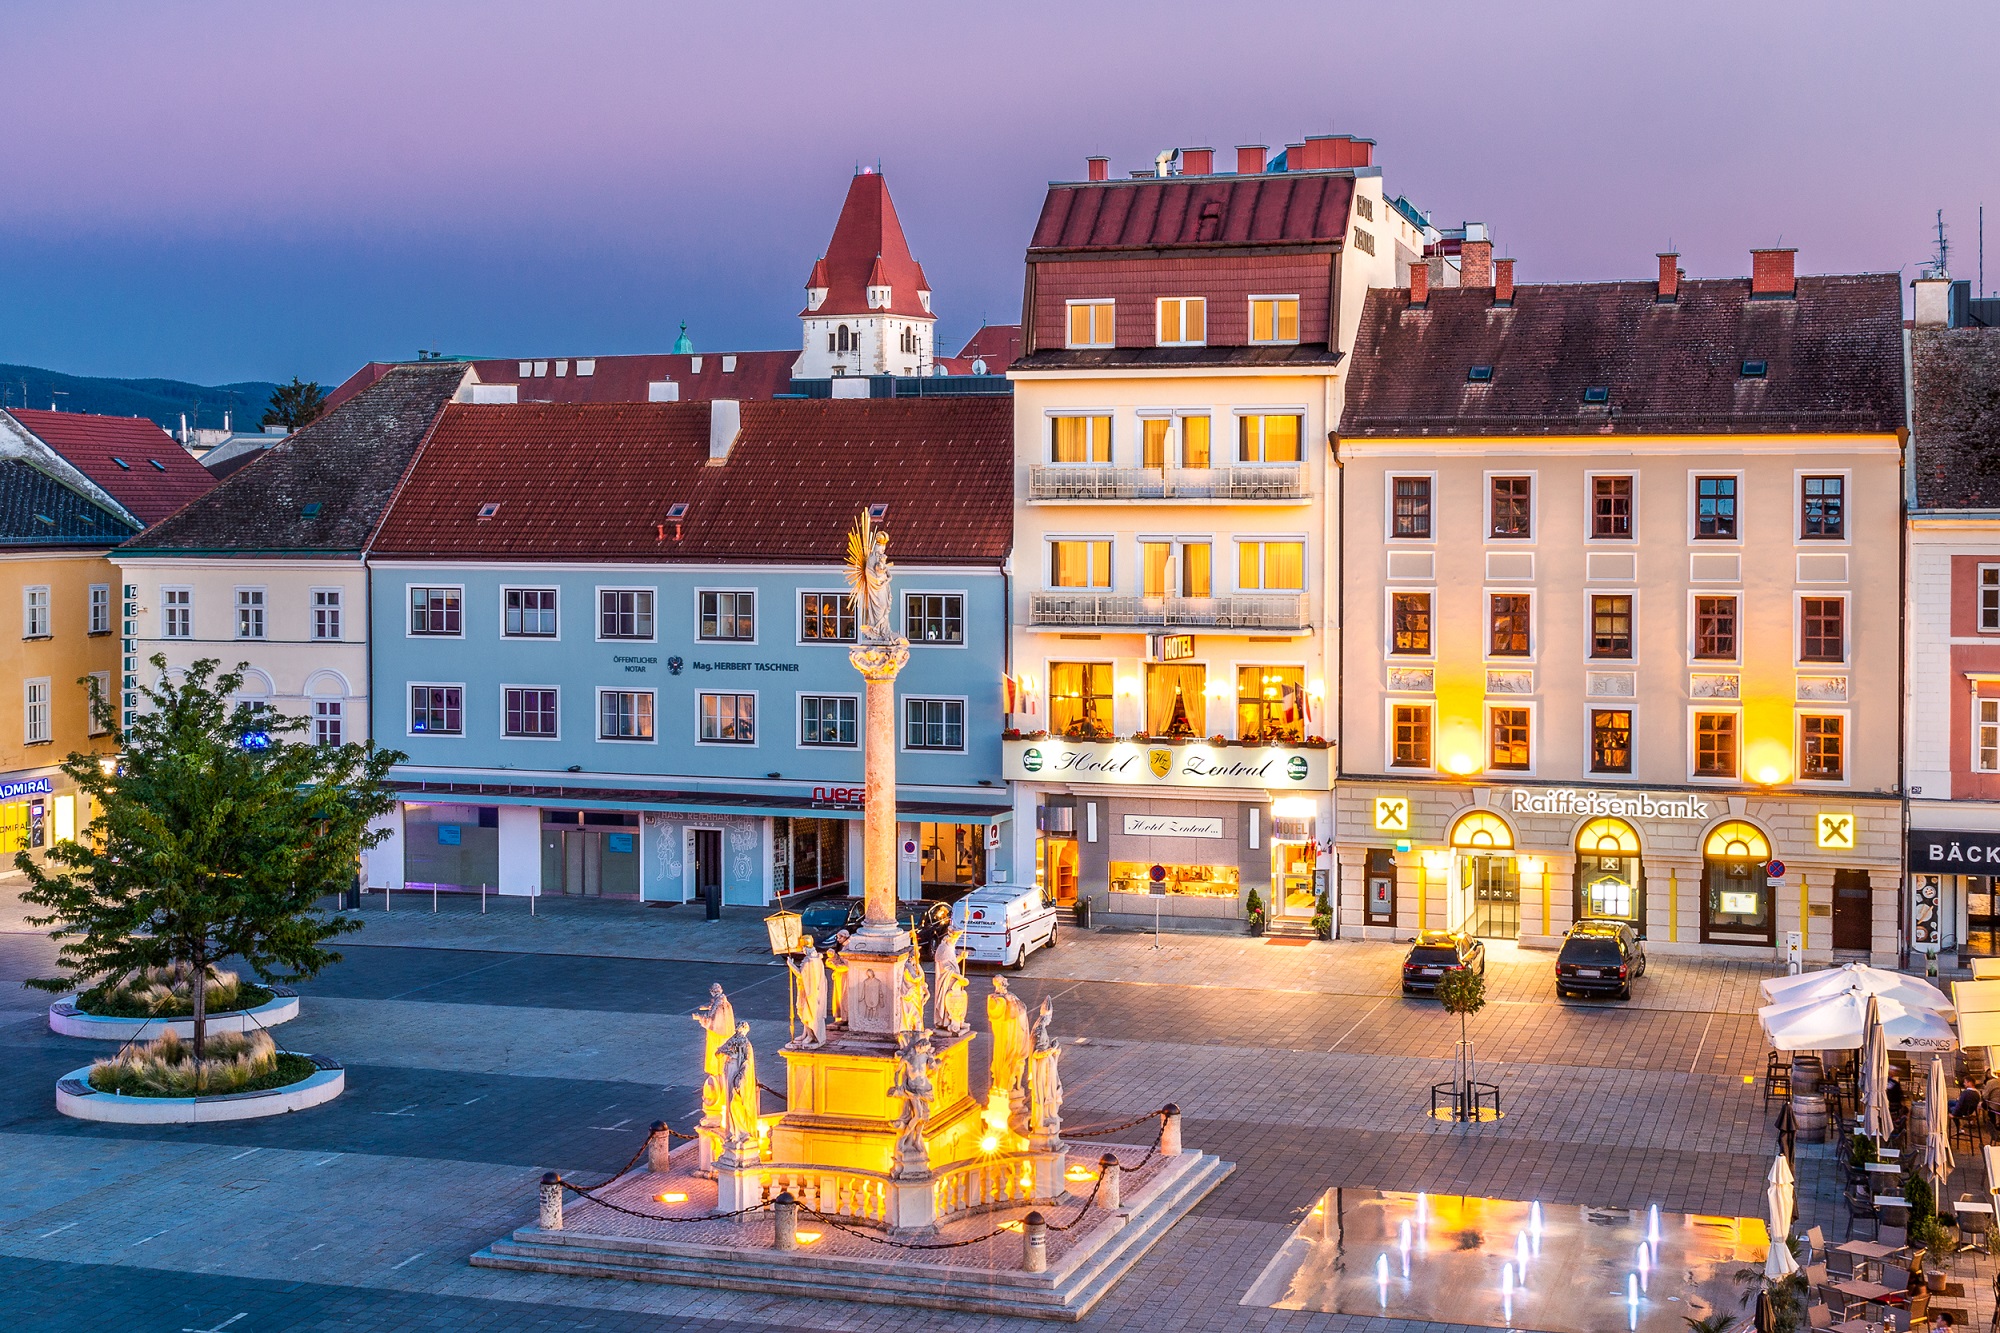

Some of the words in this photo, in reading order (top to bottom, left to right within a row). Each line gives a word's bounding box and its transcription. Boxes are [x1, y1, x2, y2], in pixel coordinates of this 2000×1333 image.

[1165, 635, 1194, 660] HOTEL
[613, 655, 658, 664] ÖFFENTLICHER
[624, 665, 646, 673] NOTAR
[692, 661, 713, 672] Mag.
[714, 662, 752, 672] HERBERT
[755, 663, 800, 672] TASCHNER
[1054, 751, 1140, 773] Hotel
[1182, 756, 1274, 778] Zentral
[1512, 789, 1709, 819] Raiffeisenbank
[661, 812, 684, 820] HAUS
[1128, 819, 1165, 831] Hotel
[1276, 822, 1308, 835] HOTEL
[1905, 1036, 1950, 1048] ORGANICS
